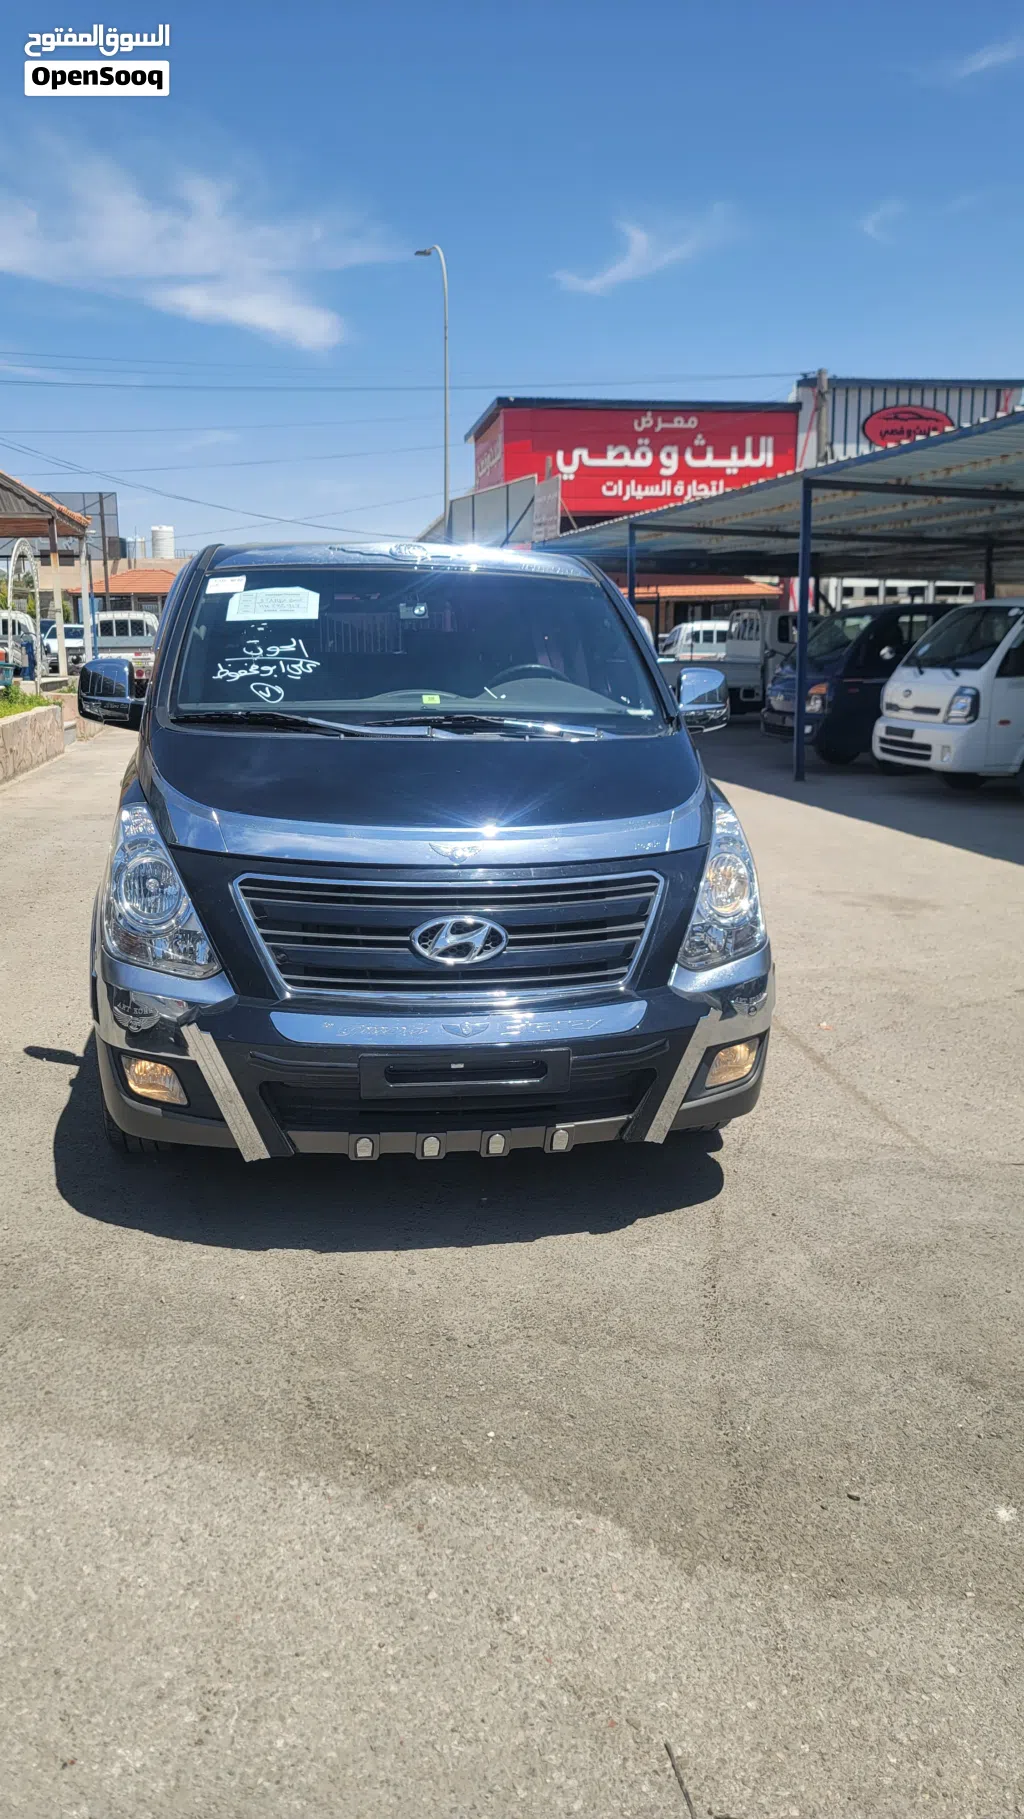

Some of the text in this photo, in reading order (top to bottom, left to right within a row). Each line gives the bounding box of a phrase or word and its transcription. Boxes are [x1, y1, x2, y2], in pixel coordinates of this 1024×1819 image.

[633, 411, 698, 433] معرض
[556, 433, 774, 481] الليث و قصي
[601, 480, 725, 502] لتجارة السيارات
